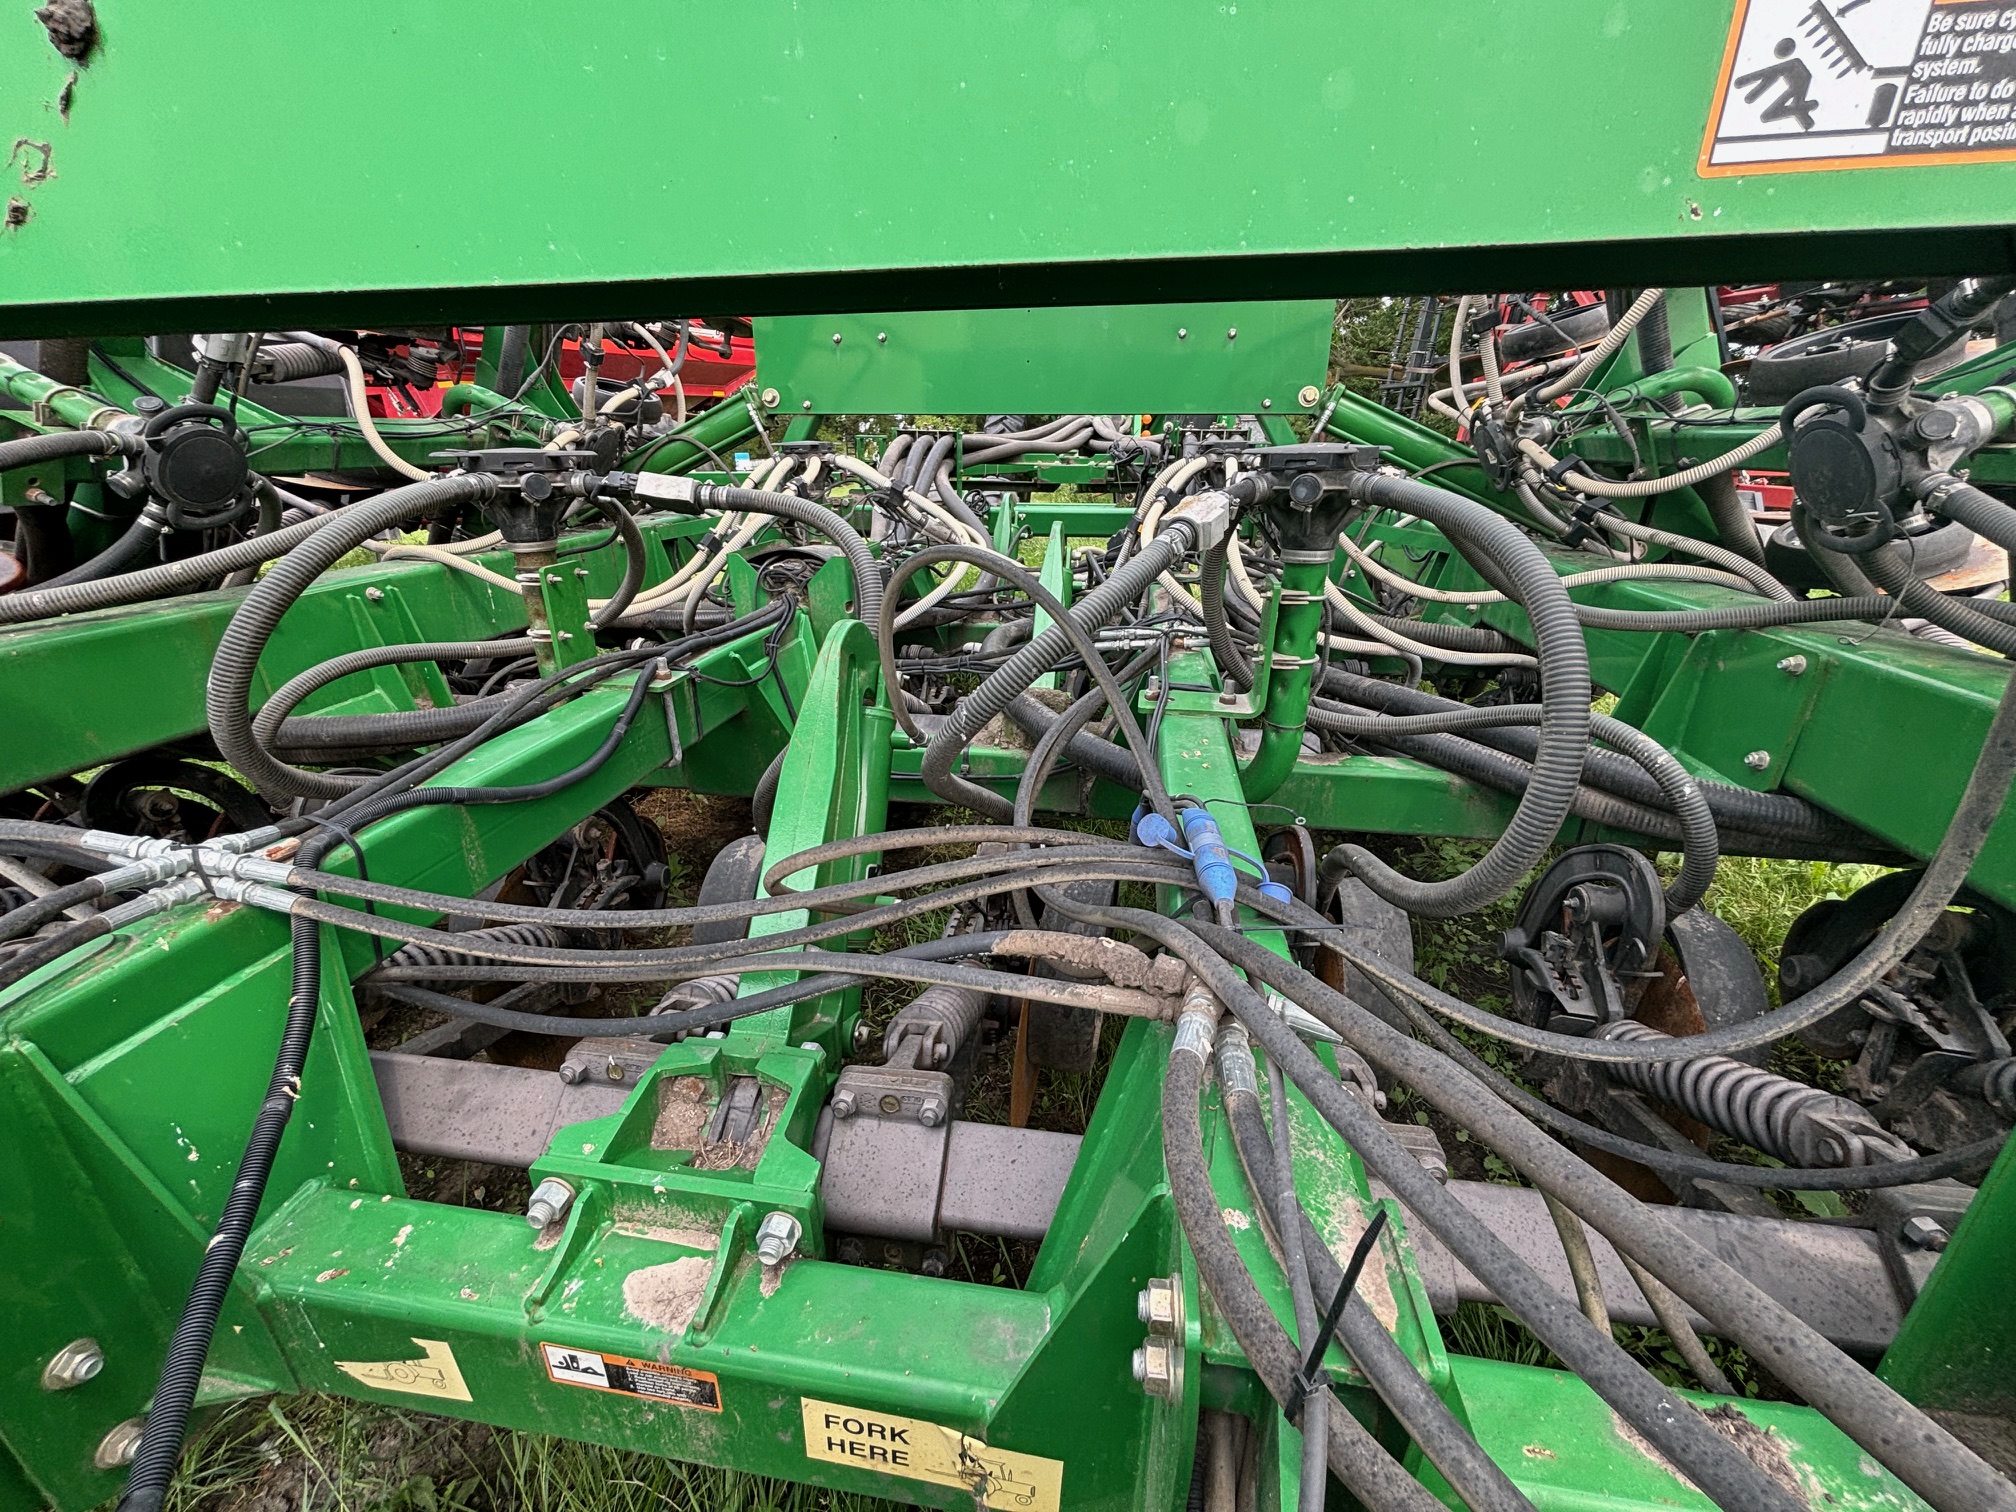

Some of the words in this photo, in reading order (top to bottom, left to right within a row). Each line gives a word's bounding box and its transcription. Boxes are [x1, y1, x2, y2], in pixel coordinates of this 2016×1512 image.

[1927, 11, 1956, 33] Be
[1954, 9, 2000, 31] sure
[1920, 33, 1963, 57] fully
[1911, 56, 1983, 81] system.
[1904, 82, 1968, 104] Failure
[1968, 80, 1990, 100] to
[1990, 77, 2016, 99] do
[1897, 104, 1960, 128] rapidly
[1960, 101, 2011, 122] when
[1891, 125, 1970, 147] transport
[641, 1361, 693, 1377] WARNING
[824, 1413, 910, 1446] FORK
[826, 1436, 910, 1468] HERE
